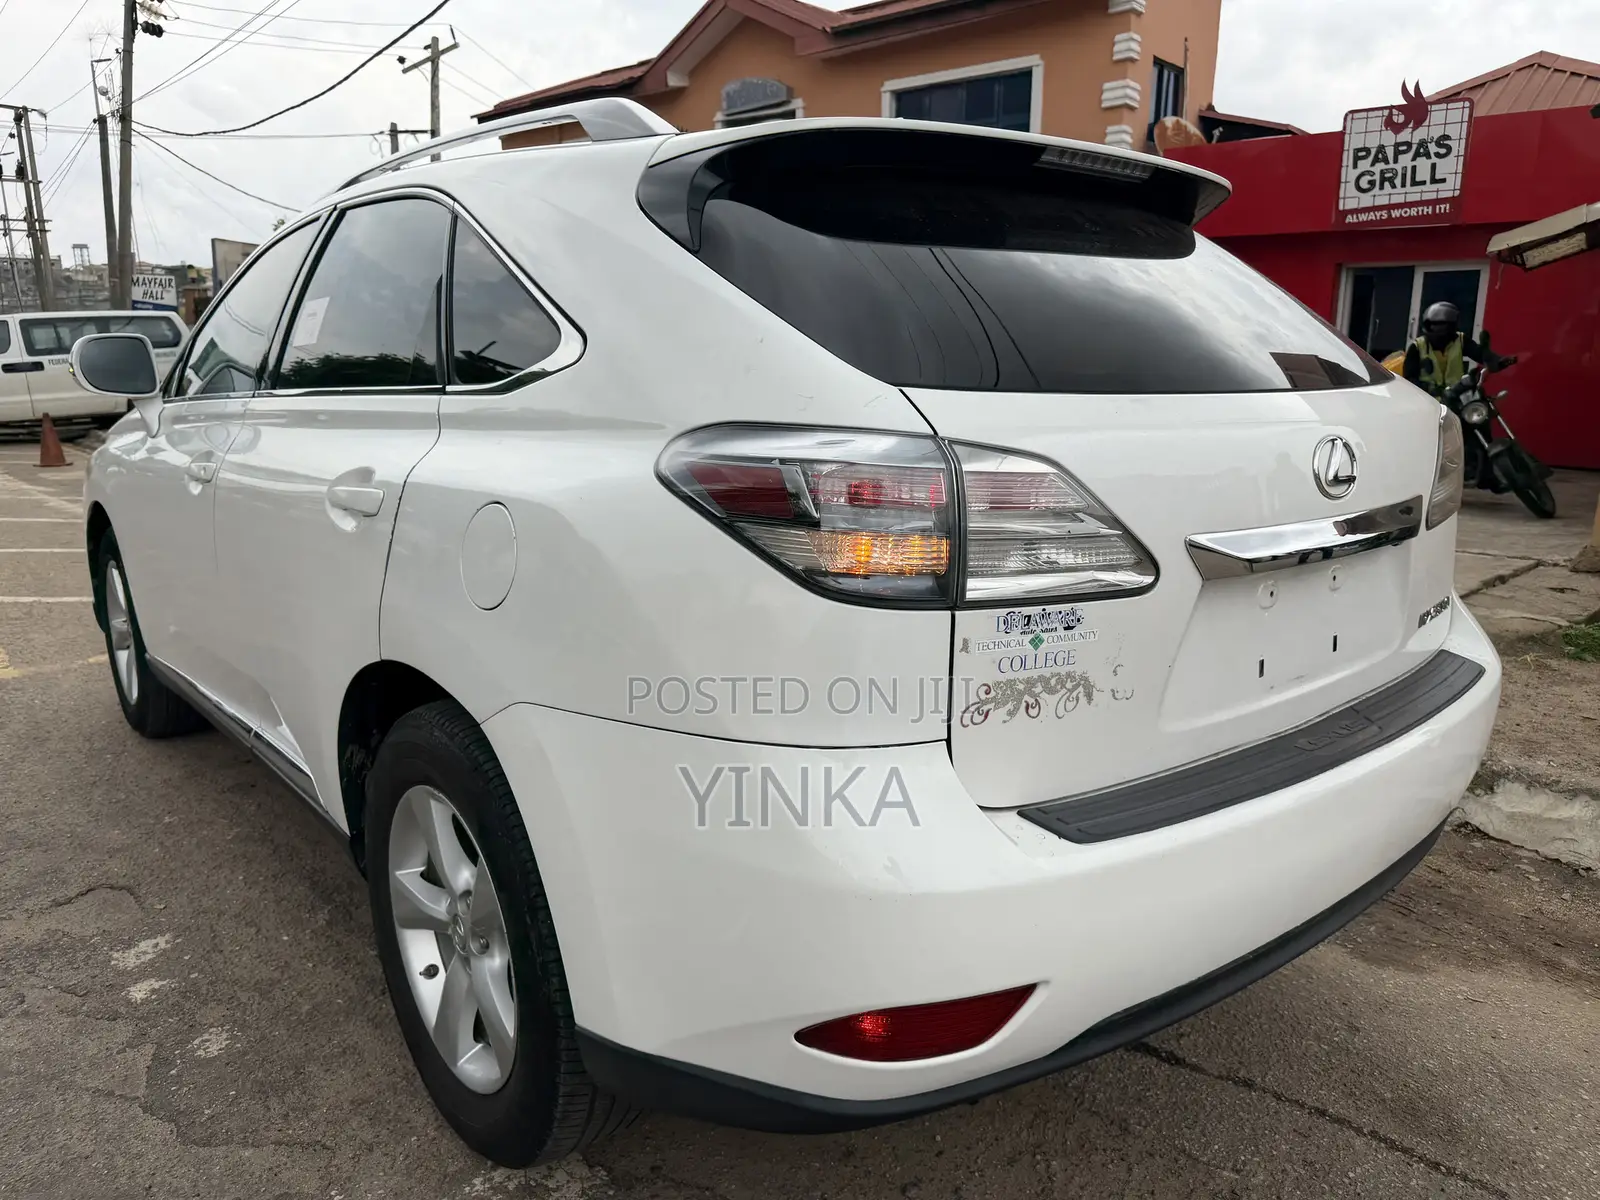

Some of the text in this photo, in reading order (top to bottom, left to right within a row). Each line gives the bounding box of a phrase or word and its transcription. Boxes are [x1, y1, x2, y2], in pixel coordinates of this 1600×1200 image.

[1352, 134, 1452, 170] PAPA'S
[1354, 162, 1447, 194] GRILL
[1345, 203, 1450, 224] ALWAYS WORTH IT!
[131, 276, 174, 289] MAYFAIR
[142, 289, 165, 301] HALL
[996, 608, 1083, 634] DELAWARE
[976, 630, 1099, 652] TECHNICAL COMMUNITY
[997, 649, 1077, 674] COLLEGE
